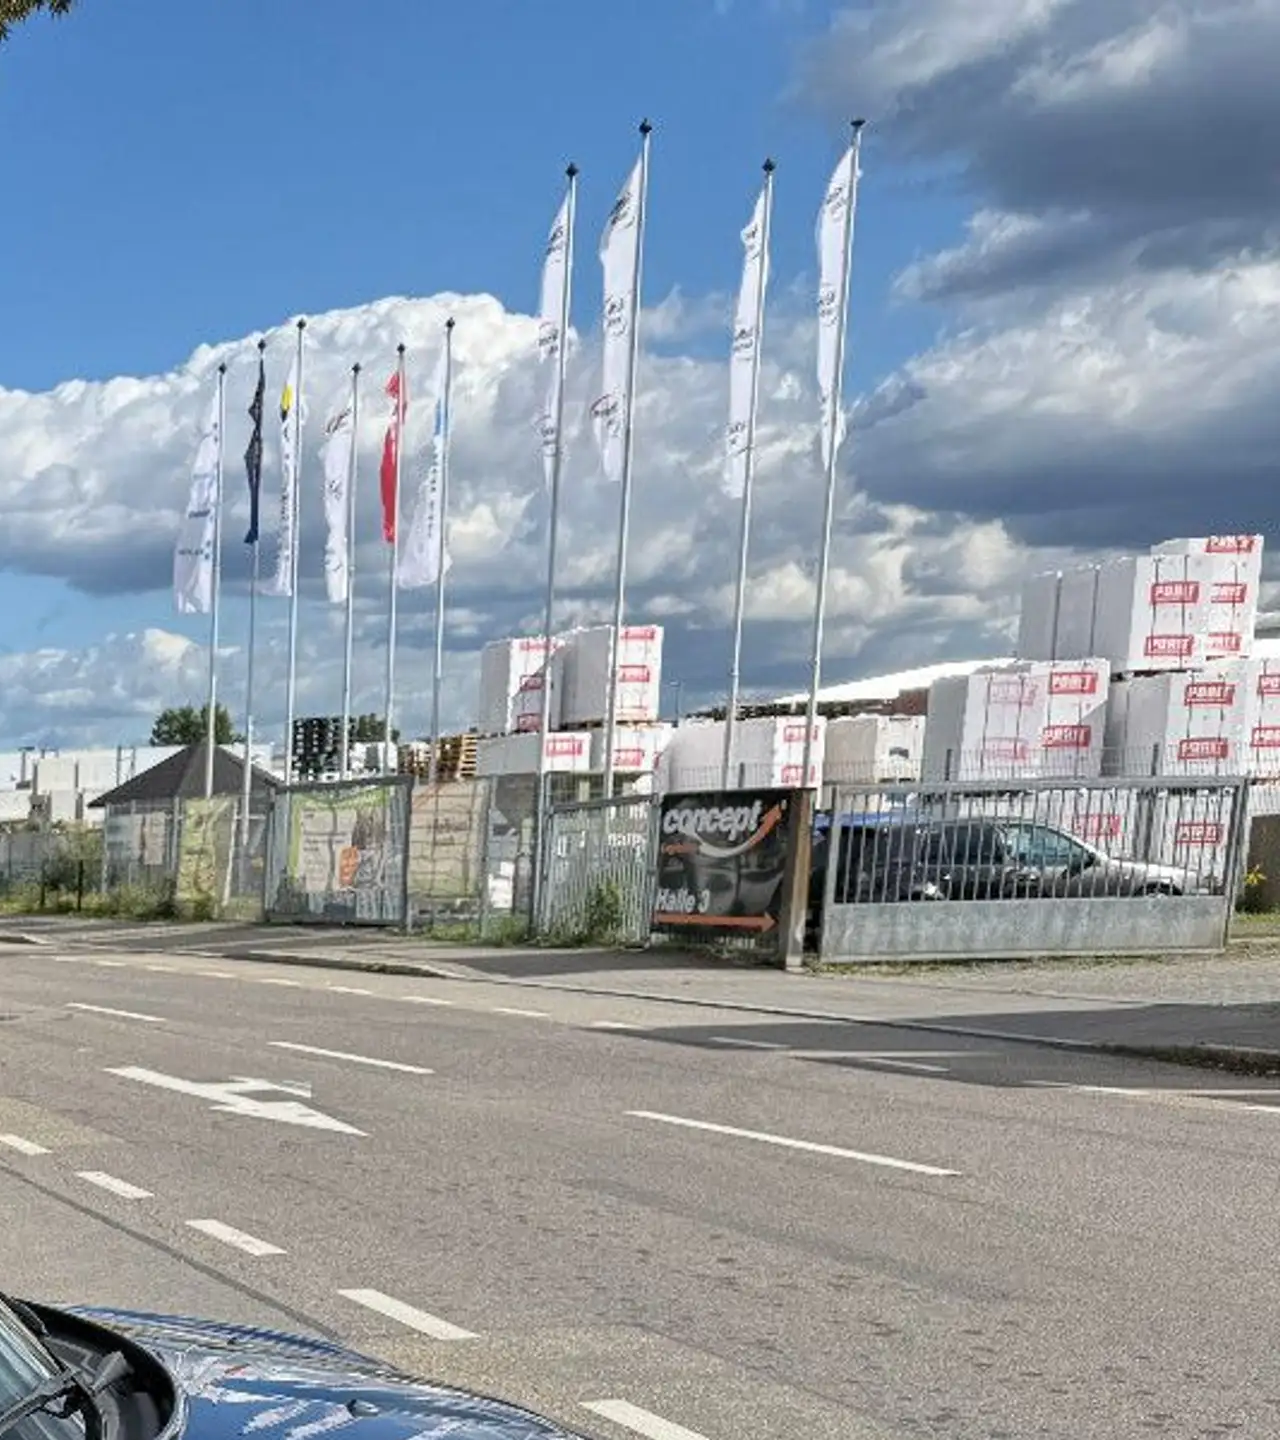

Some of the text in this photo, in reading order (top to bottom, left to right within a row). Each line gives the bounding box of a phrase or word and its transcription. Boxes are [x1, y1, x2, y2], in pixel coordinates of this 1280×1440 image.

[662, 800, 763, 841] concept
[655, 888, 710, 913] Halle 3
